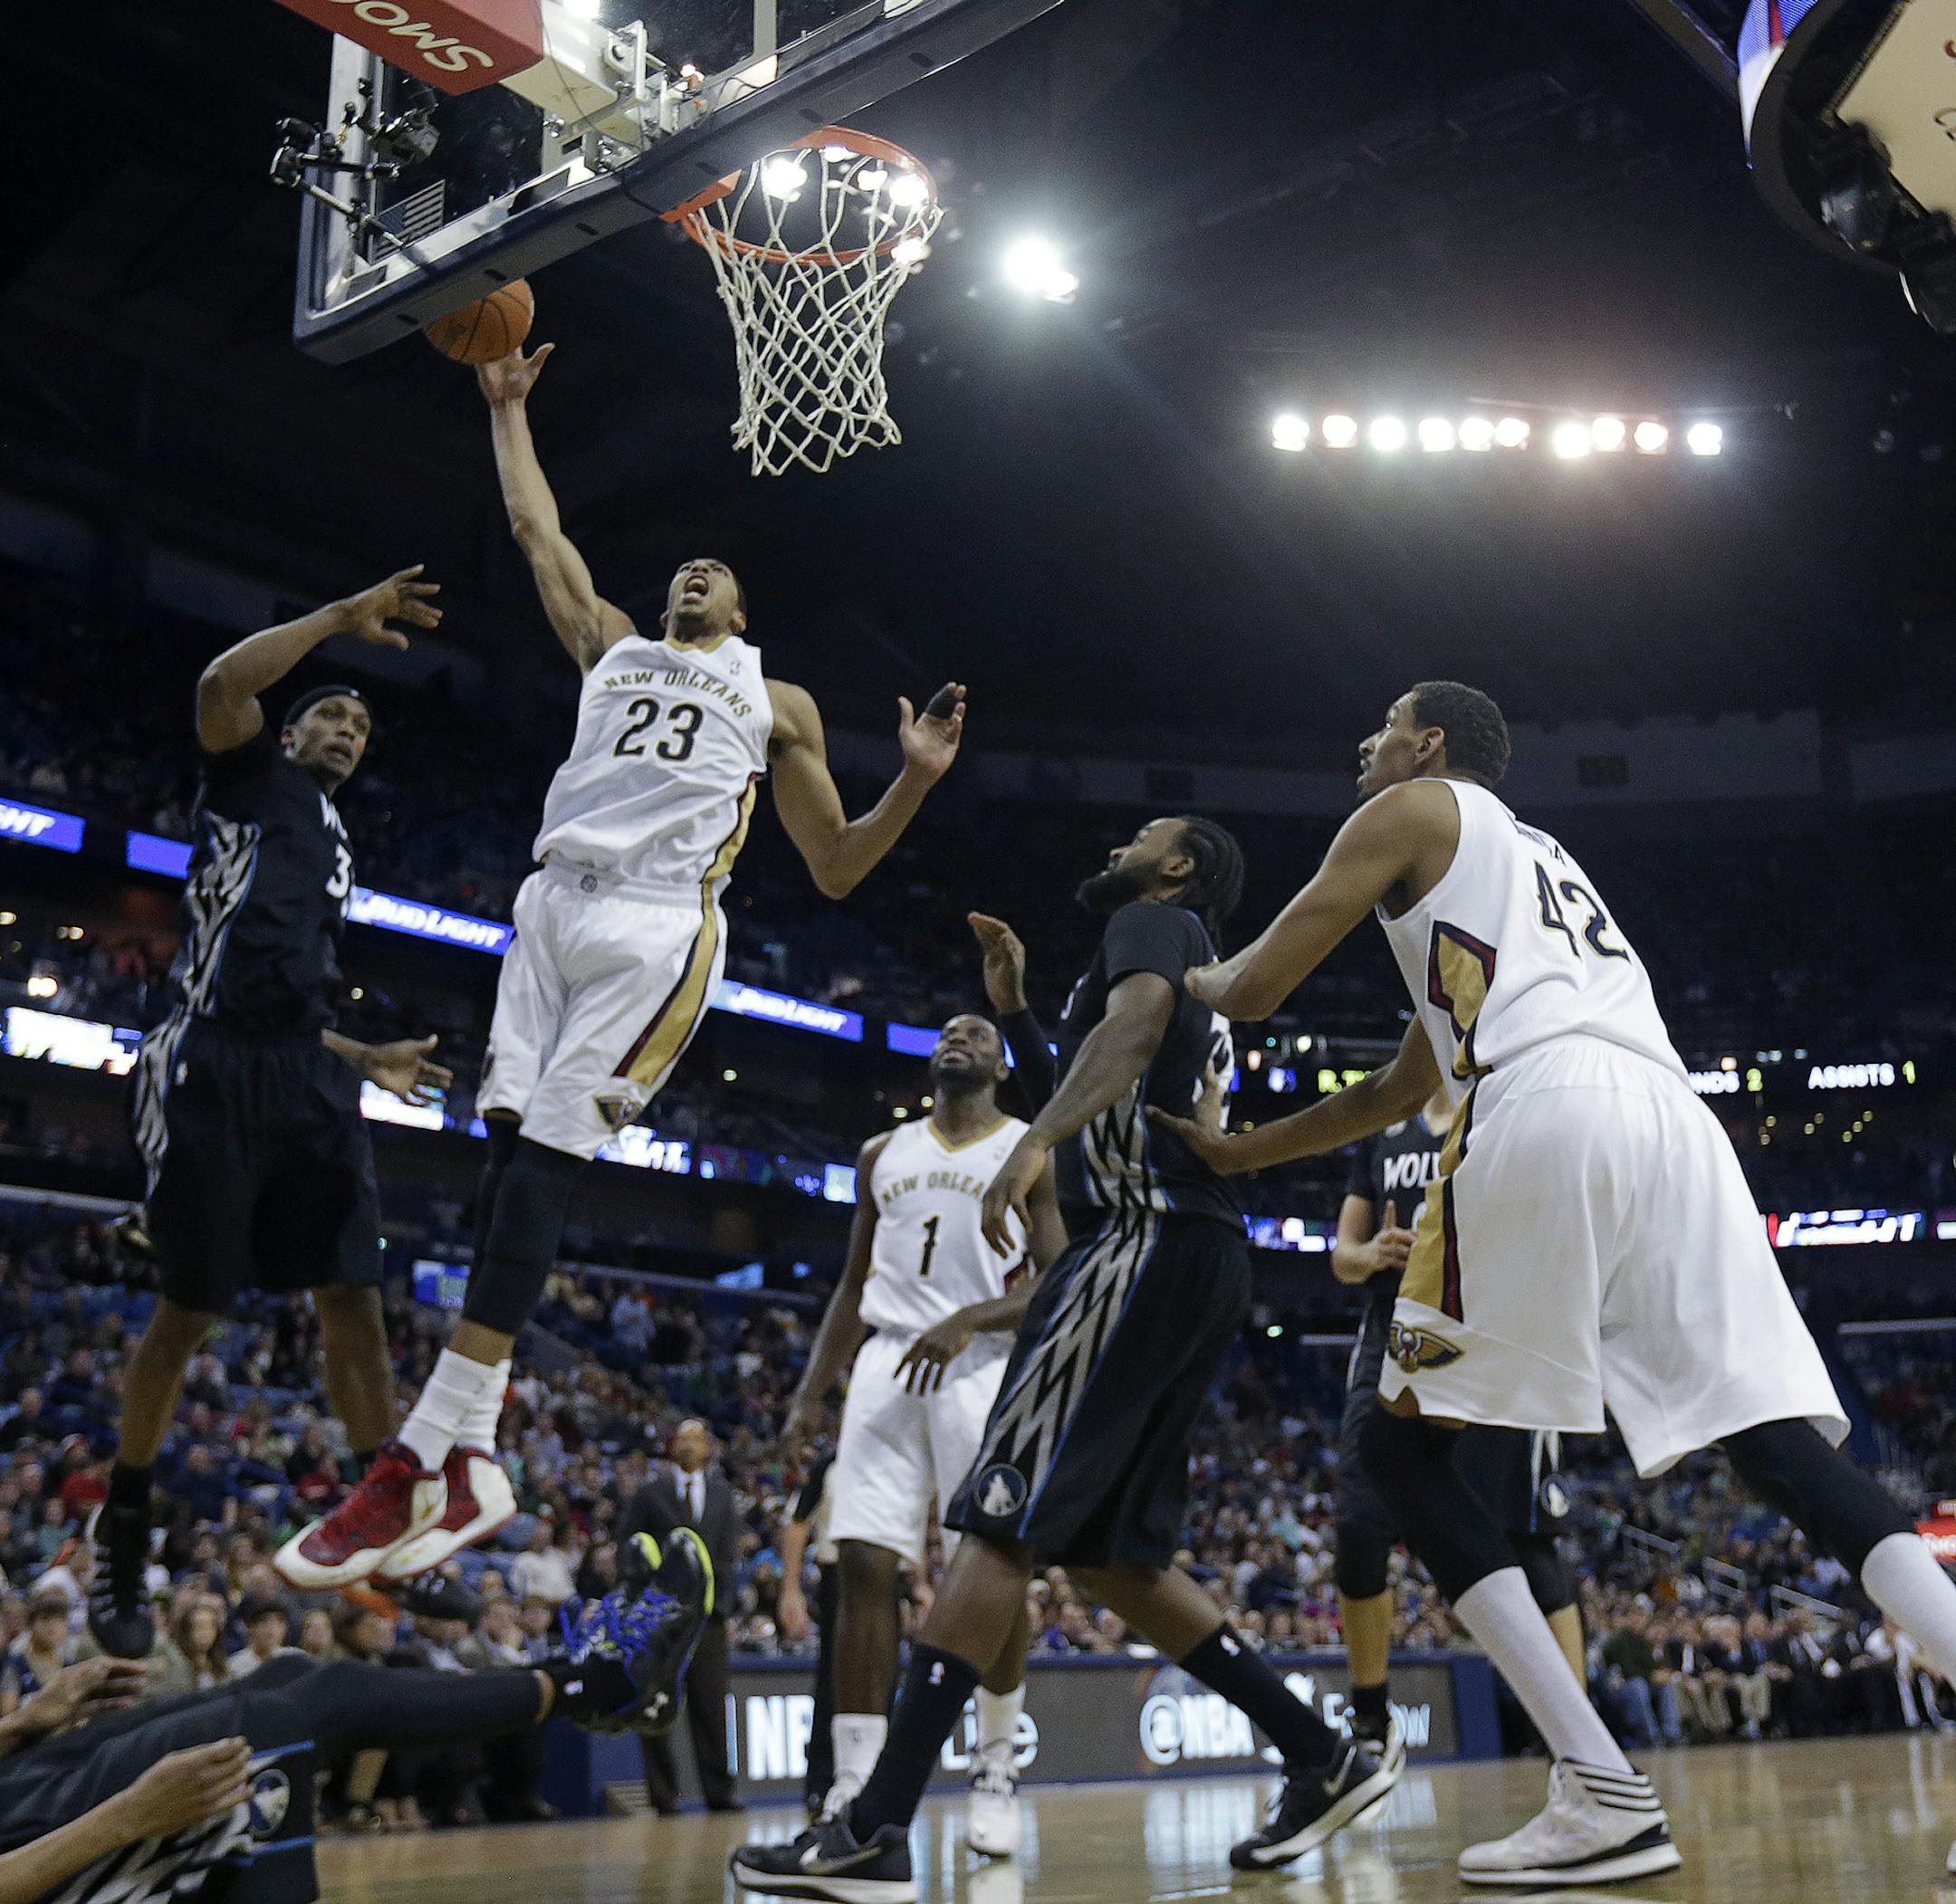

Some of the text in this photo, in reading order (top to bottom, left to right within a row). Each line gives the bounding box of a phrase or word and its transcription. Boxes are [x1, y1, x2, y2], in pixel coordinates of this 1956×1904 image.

[327, 0, 494, 72] SMO
[605, 667, 752, 718] NEW ORLEANS
[613, 697, 704, 762] 23
[1534, 859, 1633, 965] 42
[1807, 1063, 1895, 1089] ASSISTS
[1903, 1060, 1915, 1085] 1
[882, 1172, 985, 1204] NEW ORLEA
[920, 1215, 940, 1276] 1
[1139, 1694, 1255, 1765] @NBA
